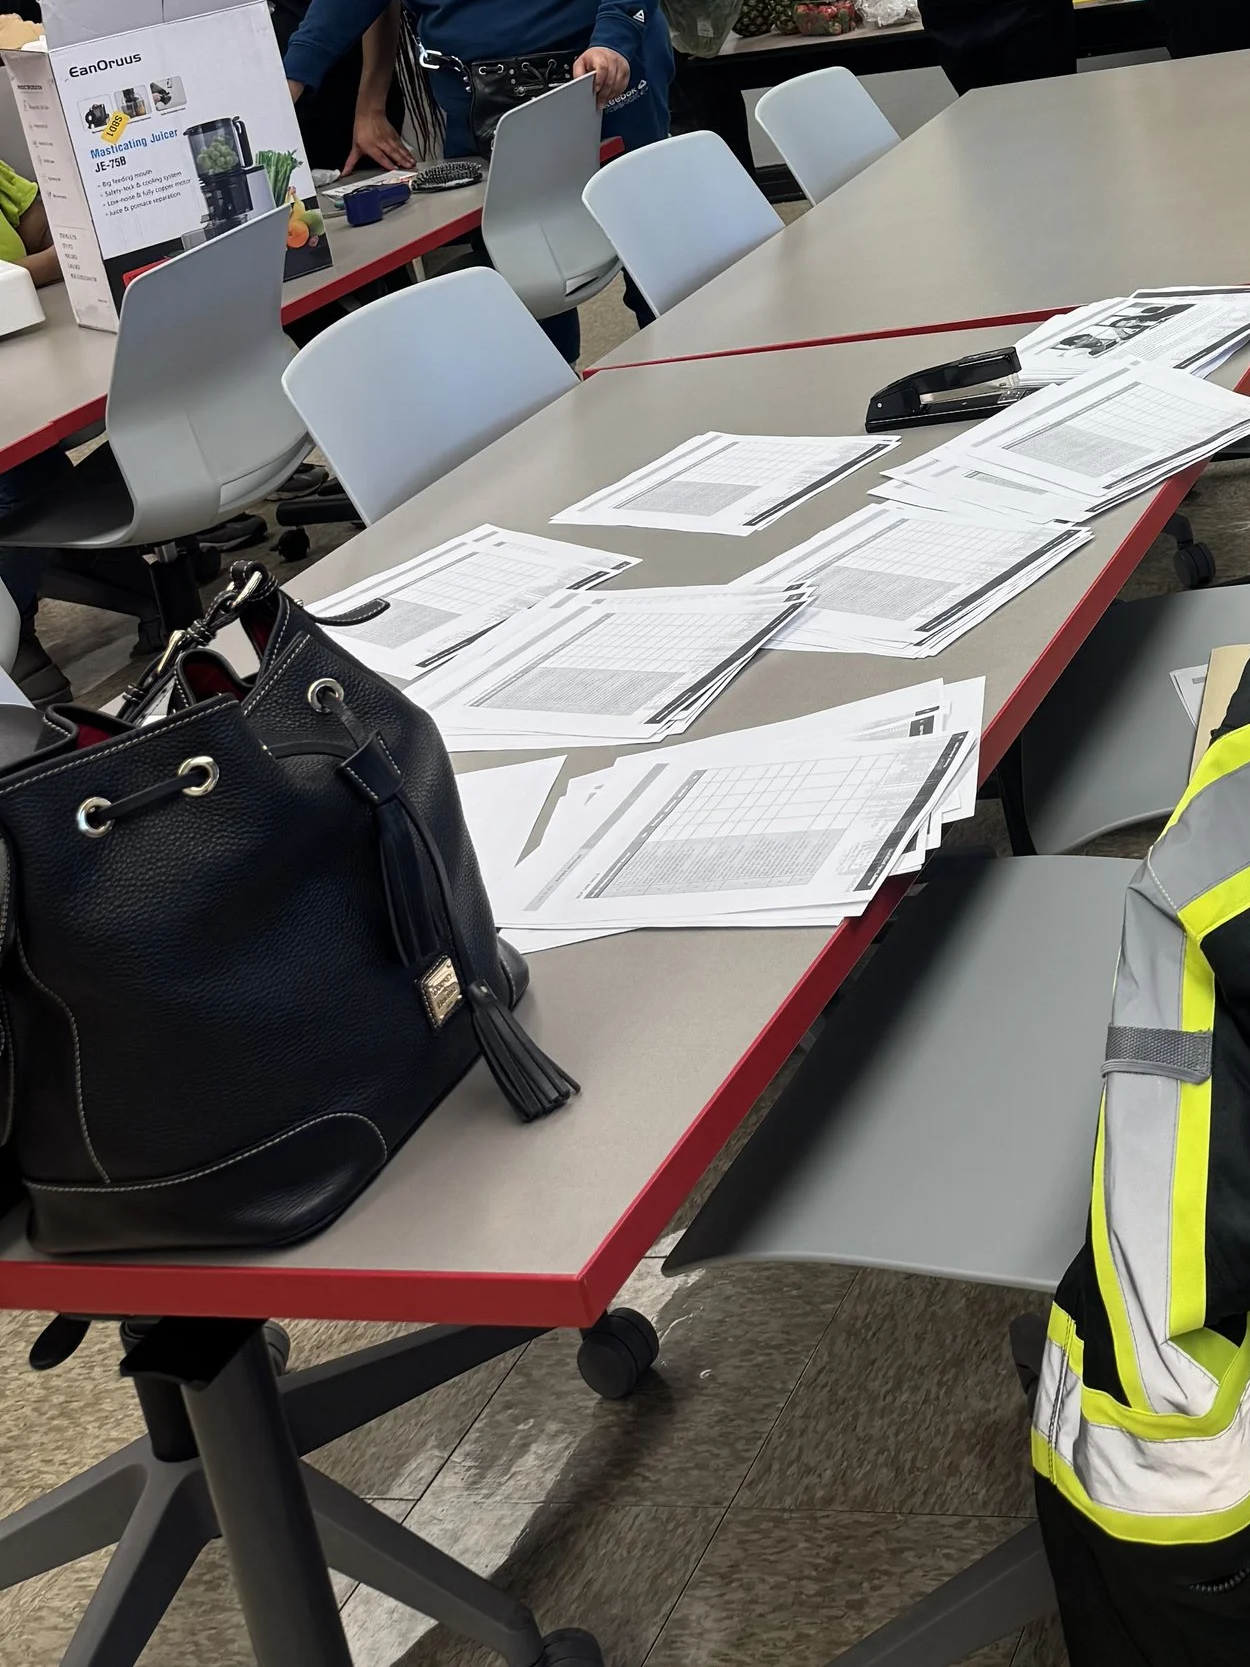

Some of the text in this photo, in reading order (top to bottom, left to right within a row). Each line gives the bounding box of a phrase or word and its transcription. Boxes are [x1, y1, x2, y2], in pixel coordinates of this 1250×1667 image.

[69, 53, 142, 78] EanOruus
[90, 129, 178, 160] Masticating Juicer
[112, 174, 134, 184] feeding
[142, 176, 163, 187] cooling
[163, 171, 182, 181] system
[174, 178, 191, 187] motor
[152, 191, 182, 204] separation
